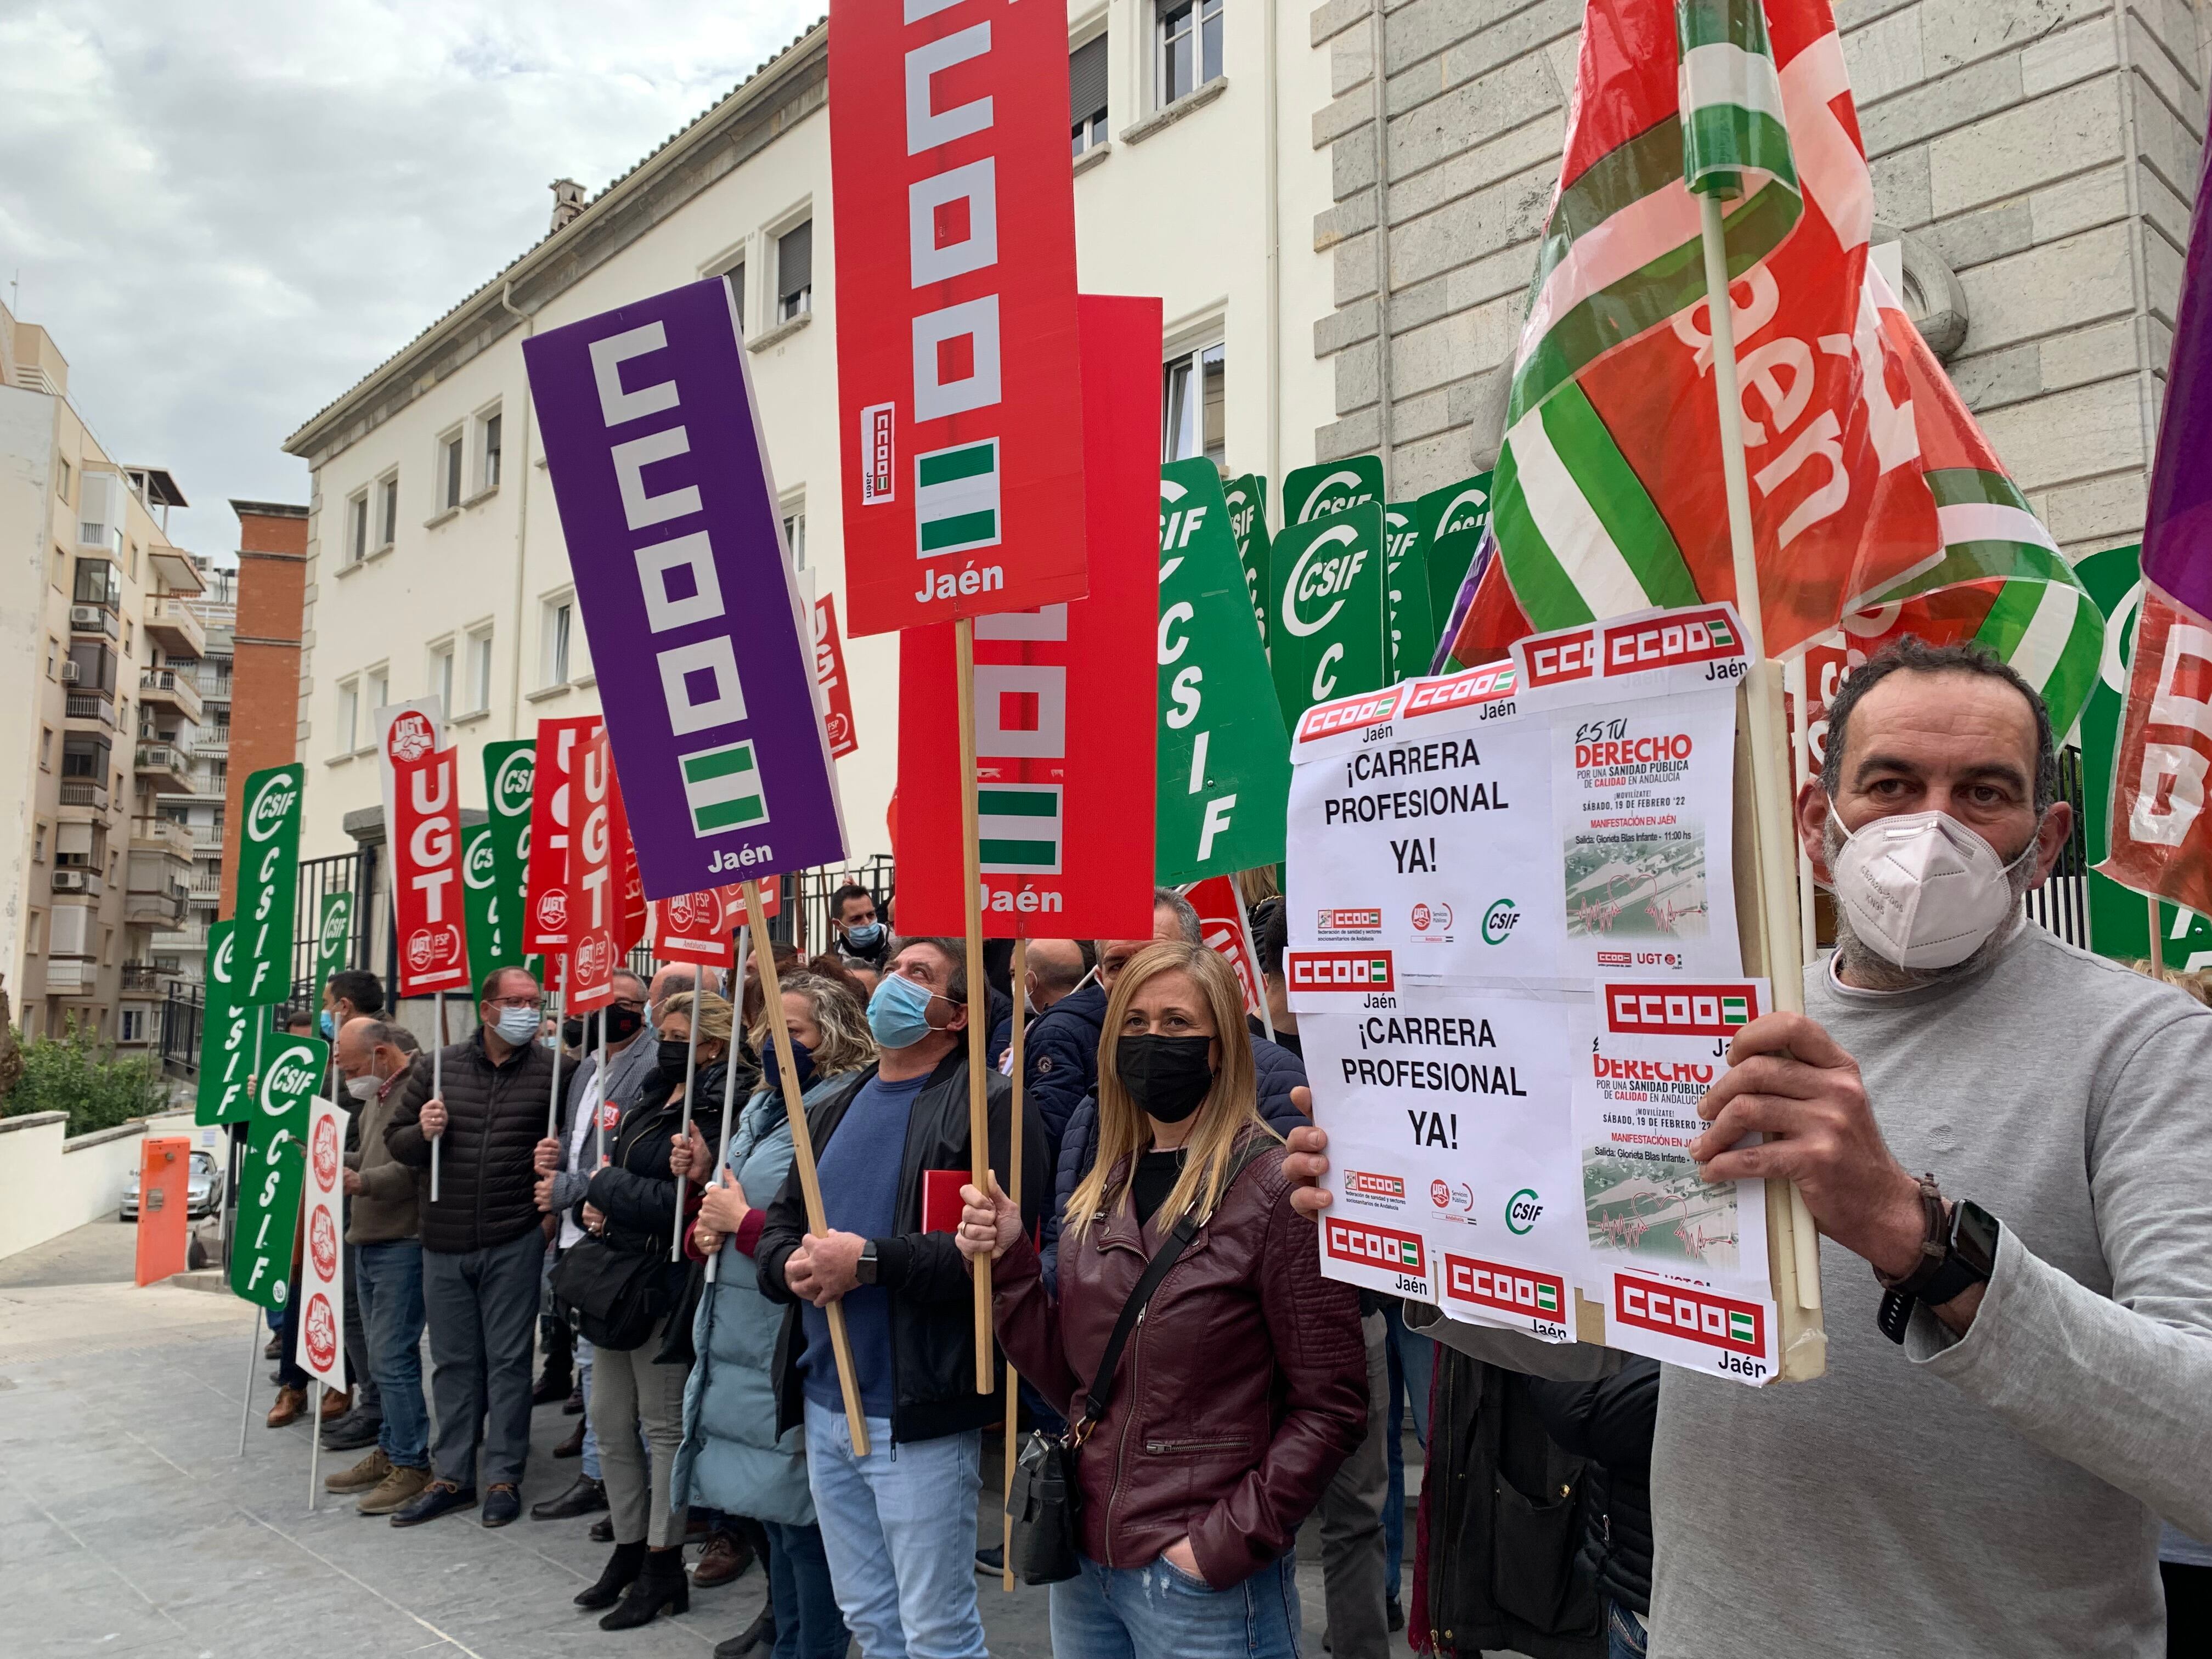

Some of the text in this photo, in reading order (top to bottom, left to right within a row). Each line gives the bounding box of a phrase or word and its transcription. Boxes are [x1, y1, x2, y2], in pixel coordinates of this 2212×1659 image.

[904, 0, 1001, 424] COO
[877, 414, 888, 476] CCOO
[588, 320, 748, 736] CCOO
[1231, 504, 1255, 539] SIF
[1386, 532, 1419, 557] SIF
[915, 560, 1004, 603] Jaén
[1298, 549, 1369, 602] CSIF
[1611, 622, 1711, 666] CCOO
[1705, 658, 1748, 681] Jaén
[1410, 674, 1497, 709] CCOO
[1305, 700, 1378, 734] CCOO
[1480, 700, 1516, 721] Jaén
[394, 715, 425, 738] UGT
[827, 719, 839, 732] FSP
[1158, 601, 1237, 862] CSIF
[1362, 724, 1393, 743] Jaén
[1575, 718, 1628, 744] ES TU
[1576, 733, 1692, 769] DERECHO
[1347, 738, 1481, 788] ¡CARRERA
[1577, 759, 1689, 780] POR UNA SANIDAD PÚBLICA
[503, 768, 534, 794] CSI
[1584, 779, 1593, 788] DE
[1594, 777, 1626, 788] CALIDAD
[1628, 776, 1637, 785] EN
[257, 791, 297, 820] CSIF
[1324, 781, 1509, 825] PROFESIONAL
[1583, 800, 1613, 812] SÁBADO,
[1626, 800, 1635, 809] DE
[1638, 798, 1671, 808] FEBRERO
[1590, 813, 1677, 829] MANIFESTACIÓN EN JAÉN
[410, 760, 454, 924] UGT
[582, 737, 608, 929] UGT
[1576, 834, 1595, 845] Salida:
[1596, 834, 1620, 843] Glorieta
[1621, 833, 1635, 842] Blas
[1636, 832, 1658, 842] Infante
[1664, 831, 1682, 840] 11:00
[1683, 830, 1692, 840] hs
[707, 843, 774, 873] Jaén
[1390, 837, 1437, 874] YA!
[542, 896, 566, 912] UGT
[695, 892, 709, 908] FSP
[249, 847, 280, 997] CSIF
[1335, 912, 1370, 925] CCOO
[1413, 907, 1429, 919] UGT
[1489, 913, 1521, 929] CSIF
[325, 917, 347, 939] CSIF
[411, 935, 431, 955] UGT
[434, 933, 450, 947] FSP
[595, 940, 606, 957] FSP
[578, 944, 593, 967] UGT
[1599, 953, 1624, 962] CCOO
[1637, 952, 1662, 965] UGT
[1294, 959, 1370, 984] CCOO
[1363, 993, 1397, 1009] Jaén
[1613, 994, 1720, 1025] CCOO
[1358, 1017, 1497, 1050] ¡CARRERA
[1341, 1058, 1527, 1097] PROFESIONAL
[1593, 1053, 1714, 1084] DERECHO
[272, 1065, 317, 1096] CSIF
[1596, 1079, 1611, 1090] POR
[1612, 1080, 1627, 1091] UNA
[1629, 1080, 1668, 1093] SANIDAD
[1604, 1090, 1613, 1099] DE
[1615, 1091, 1647, 1102] CALIDAD
[1650, 1093, 1659, 1103] EN
[1407, 1109, 1458, 1150] YA!
[1603, 1111, 1635, 1126] SÁBADO,
[1637, 1117, 1645, 1126] 19
[1649, 1117, 1658, 1127] DE
[1661, 1119, 1696, 1130] FEBRERO
[1611, 1133, 1670, 1146] MANIFESTACIÓN
[1672, 1137, 1682, 1147] EN
[1595, 1146, 1616, 1157] Salida:
[1617, 1149, 1644, 1160] Glorieta
[1645, 1151, 1660, 1161] Blas
[1661, 1152, 1686, 1164] Infante
[1345, 1190, 1365, 1198] federación
[1359, 1175, 1394, 1193] CCOO
[1432, 1183, 1447, 1197] UGT
[1452, 1190, 1468, 1198] Servicios
[247, 1128, 289, 1291] CSIF
[1346, 1198, 1374, 1207] sociosanitarios
[1512, 1201, 1544, 1223] CSIF
[1331, 1226, 1401, 1263] CCOO
[1395, 1273, 1427, 1296] Jaén
[1452, 1263, 1535, 1307] CCOO
[1622, 1285, 1727, 1338] CCOO
[1530, 1319, 1567, 1340] Jaén
